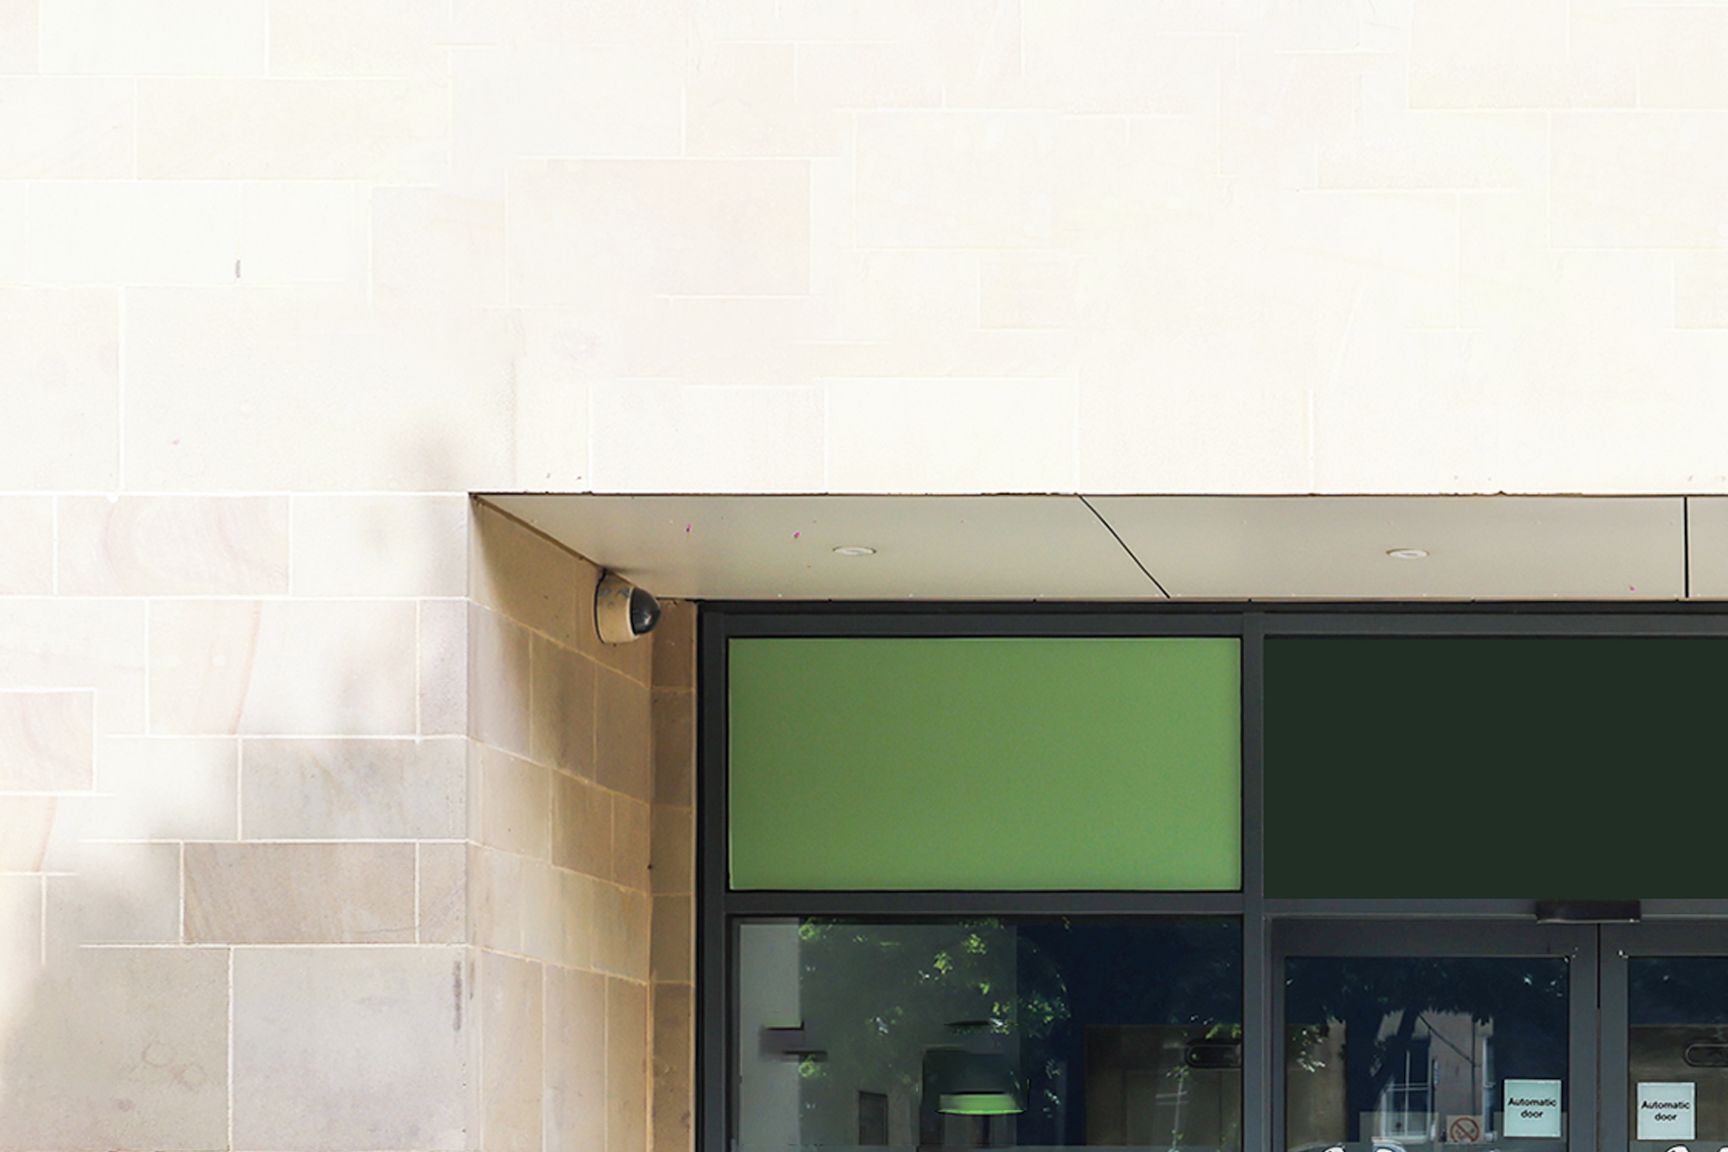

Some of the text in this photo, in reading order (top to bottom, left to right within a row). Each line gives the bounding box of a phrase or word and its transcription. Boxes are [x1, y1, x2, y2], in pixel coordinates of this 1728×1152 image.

[1508, 1098, 1557, 1107] Automatic
[1641, 1101, 1690, 1110] Automatic
[1521, 1109, 1544, 1118] door
[1655, 1113, 1677, 1121] door
